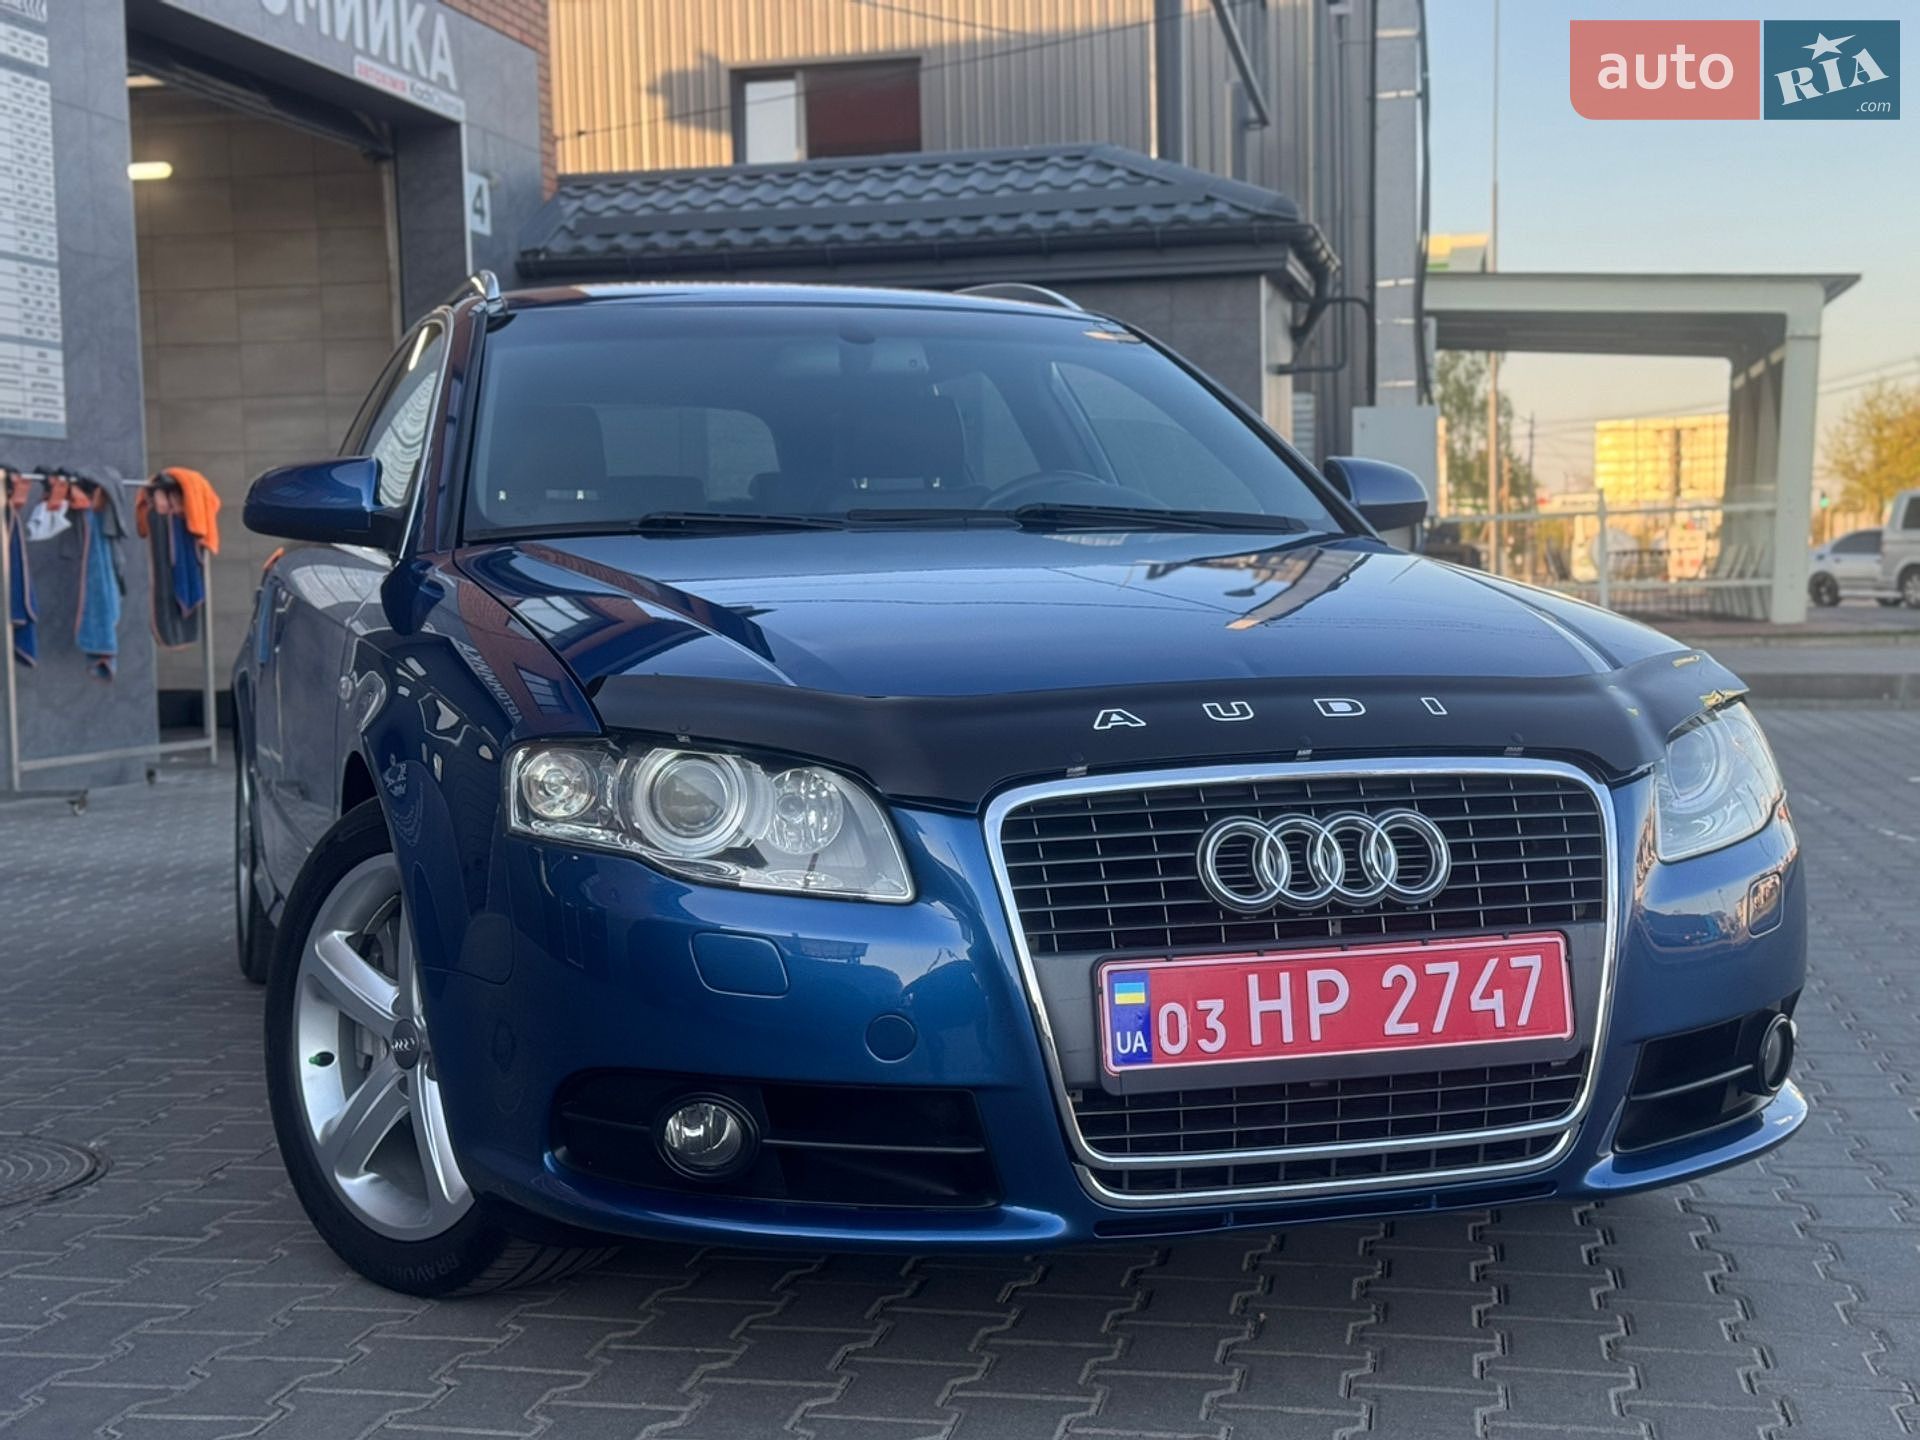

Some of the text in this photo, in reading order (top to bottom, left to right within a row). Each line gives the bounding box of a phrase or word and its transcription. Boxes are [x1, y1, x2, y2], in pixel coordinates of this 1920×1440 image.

[472, 184, 486, 225] 4
[1157, 954, 1542, 1056] 03 HP 2747
[1116, 1030, 1148, 1055] UA
